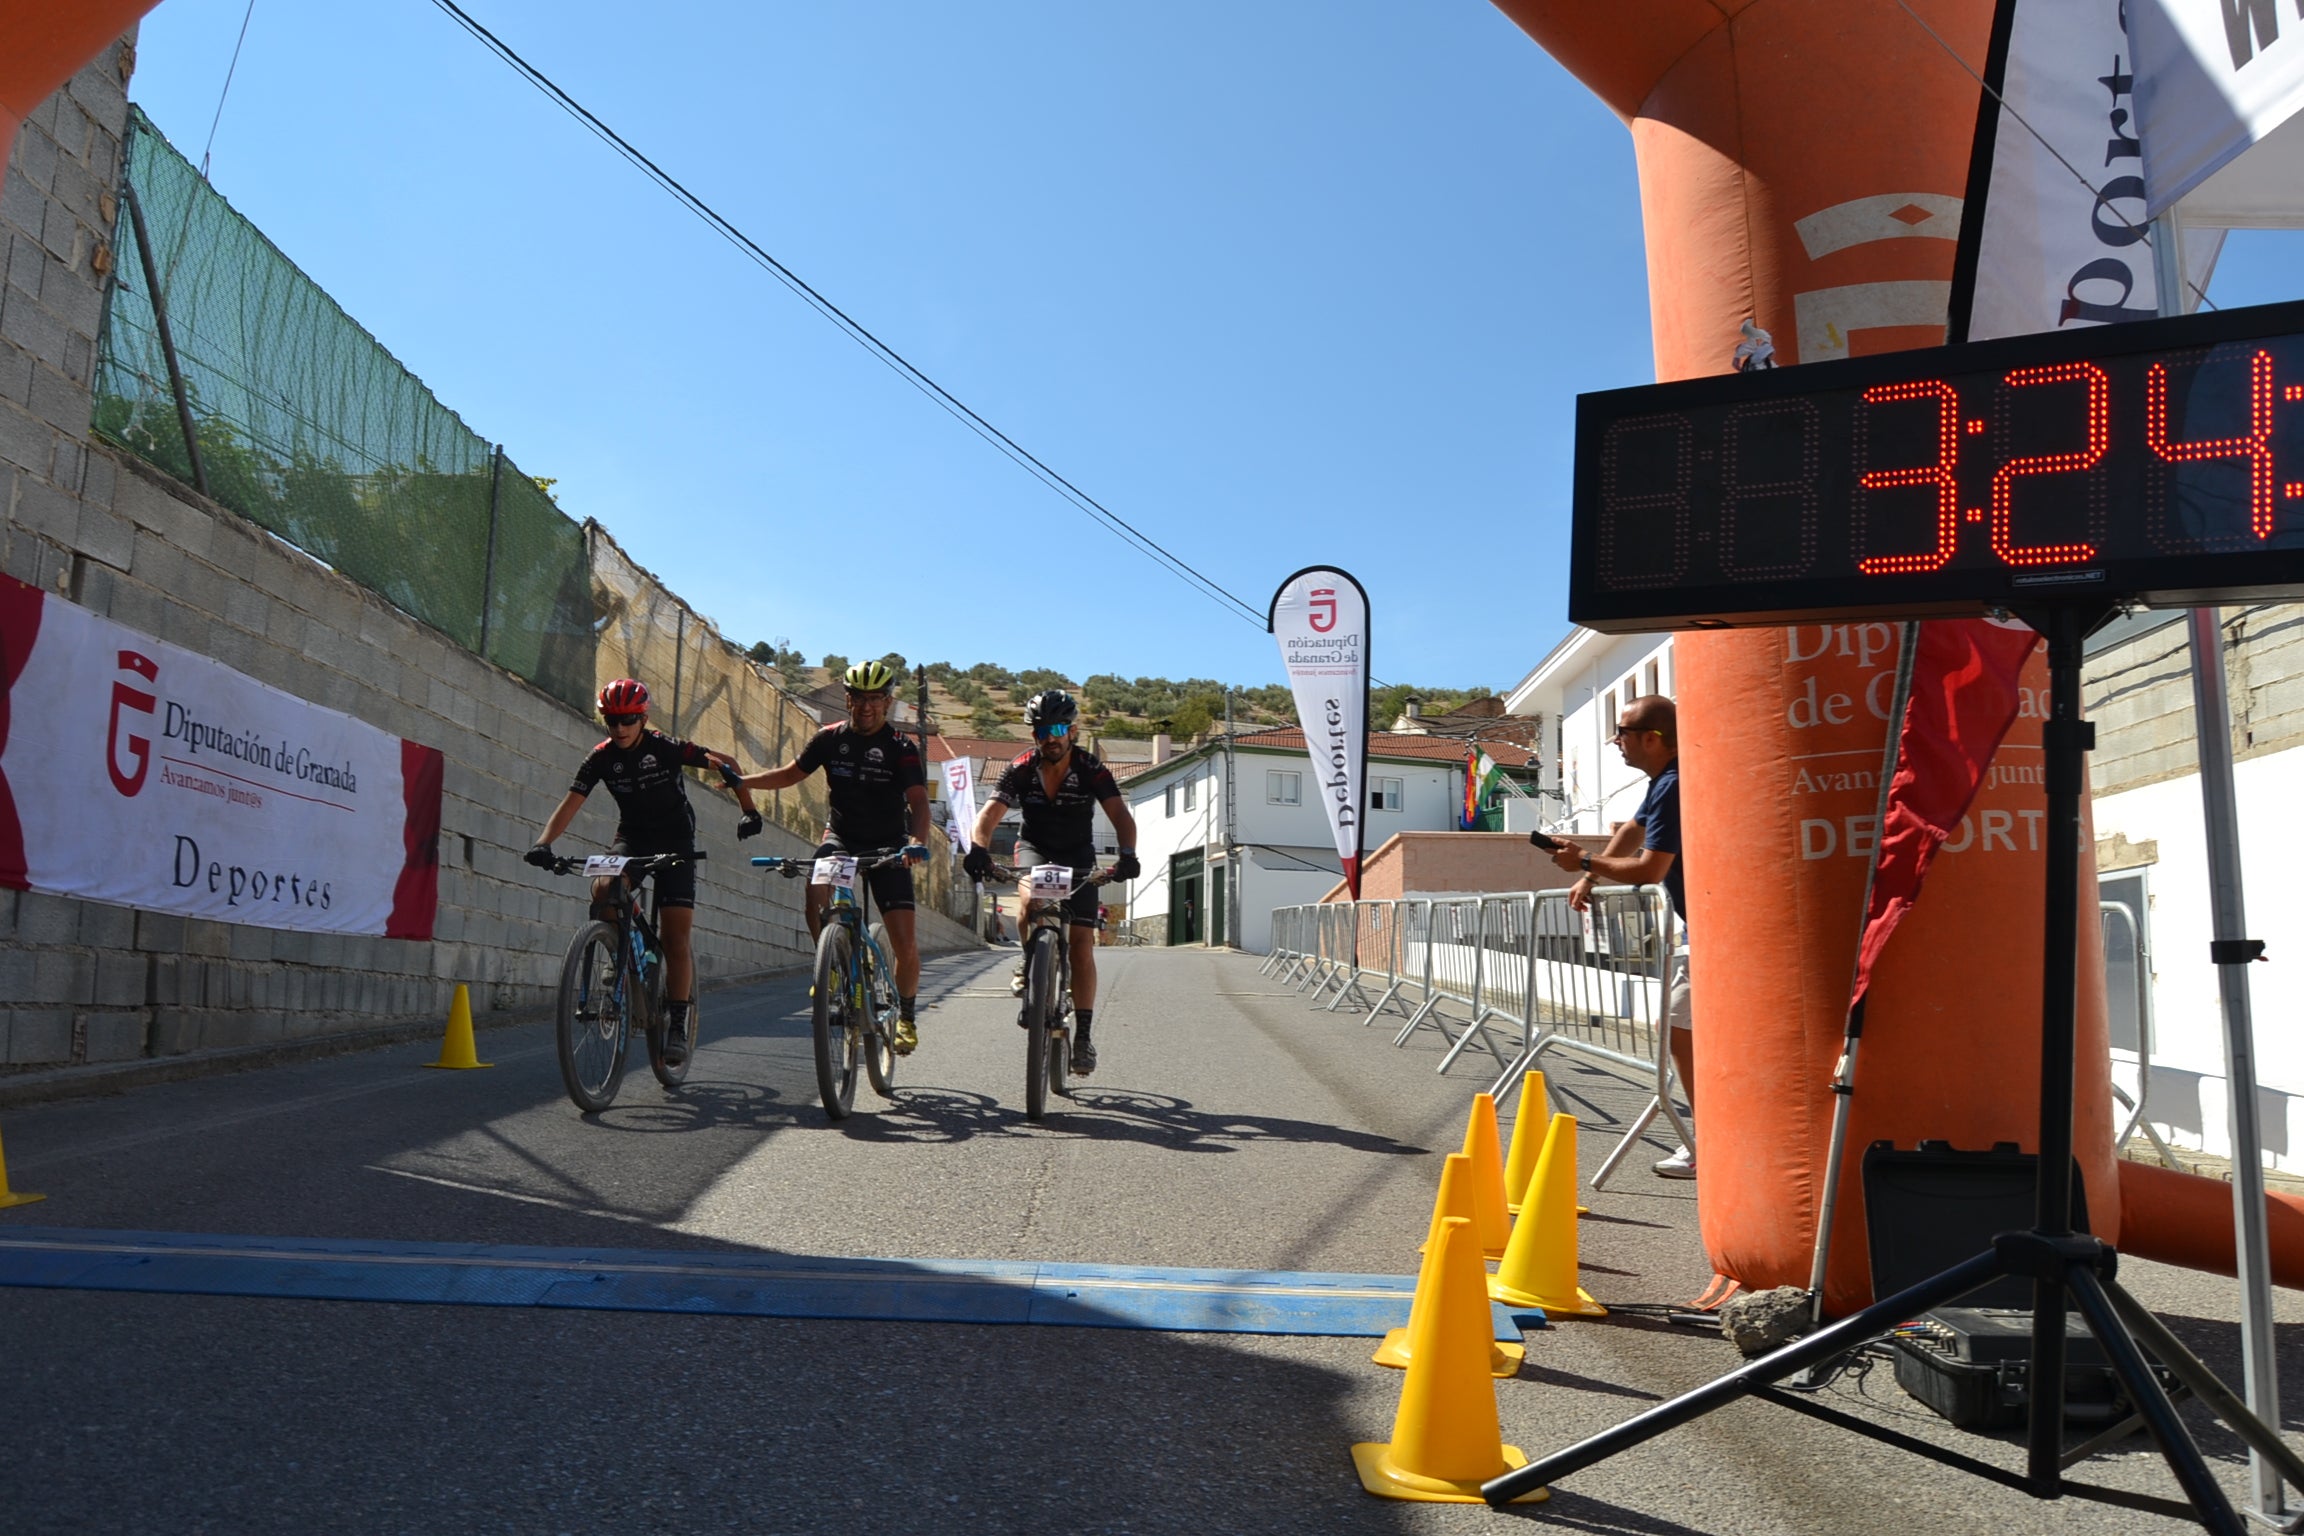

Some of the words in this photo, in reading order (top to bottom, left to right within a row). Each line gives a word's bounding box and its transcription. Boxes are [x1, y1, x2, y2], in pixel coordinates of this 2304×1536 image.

[1788, 675, 1852, 728] de
[163, 700, 271, 768] Diputación
[275, 741, 294, 775] de
[296, 747, 357, 793] Granada
[160, 764, 225, 798] Avanzamos
[1988, 758, 2044, 790] junt
[172, 834, 331, 910] Deportes
[1044, 871, 1060, 883] 81
